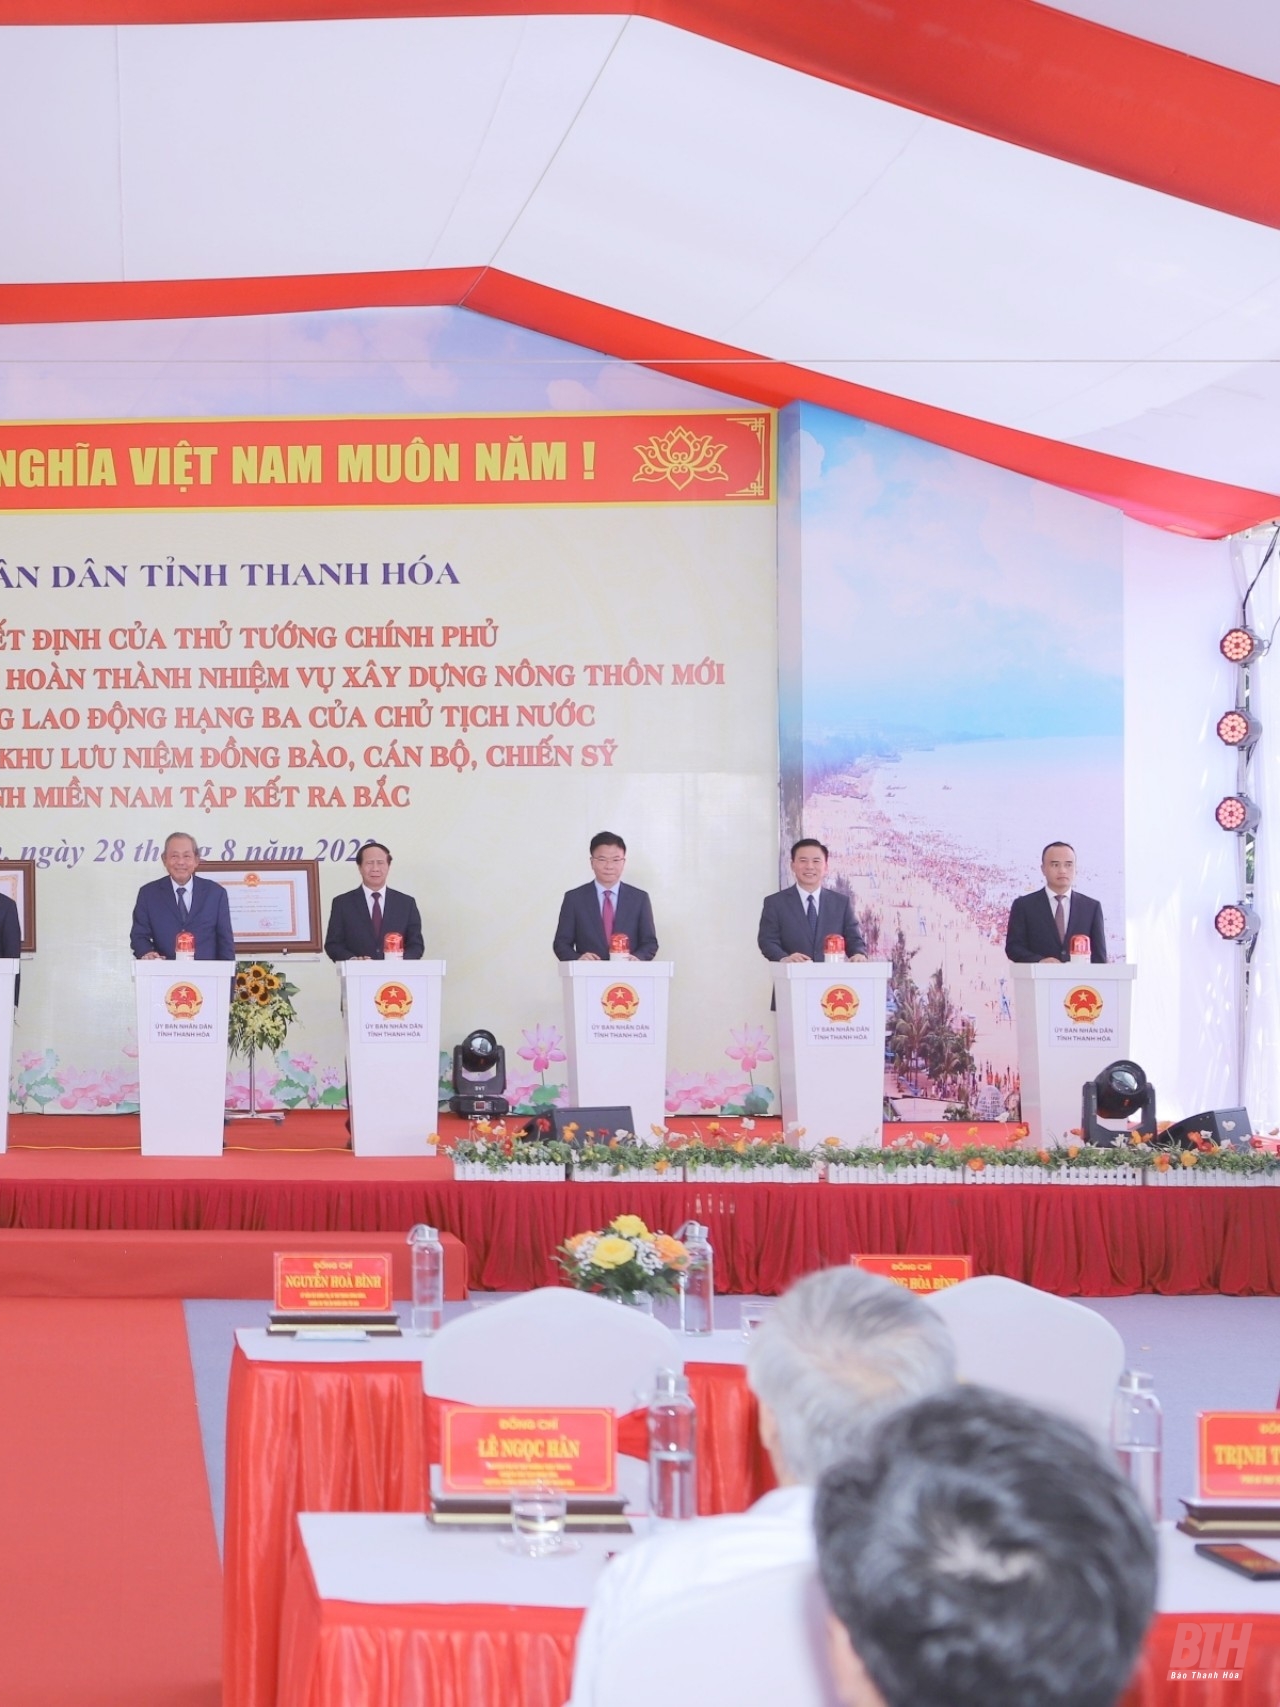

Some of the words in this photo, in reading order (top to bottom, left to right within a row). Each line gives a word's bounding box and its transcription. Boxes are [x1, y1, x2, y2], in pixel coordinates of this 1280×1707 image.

[128, 439, 219, 493] VIỆT
[232, 444, 322, 485] NAM
[337, 436, 460, 484] MUÔN
[475, 435, 567, 482] NĂM
[583, 442, 595, 480] !
[52, 559, 128, 588] DÂN
[139, 559, 228, 587] TỈNH
[240, 562, 369, 587] THANH
[382, 557, 460, 585] HÓA
[31, 628, 102, 656] ĐỊNH
[108, 620, 167, 651] CỦA
[173, 619, 233, 650] THỦ
[239, 619, 338, 650] TƯỚNG
[344, 619, 435, 649] CHÍNH
[441, 617, 499, 648] PHỦ
[5, 661, 87, 691] HOÀN
[92, 660, 192, 690] THÀNH
[198, 659, 290, 695] NHIỆM
[295, 666, 336, 694] VỤ
[341, 659, 402, 688] XÂY
[408, 662, 488, 694] DỰNG
[494, 658, 576, 687] NÔNG
[583, 657, 664, 686] THÔN
[671, 657, 725, 685] MỚI
[21, 707, 81, 730] LAO
[86, 700, 167, 735] ĐỘNG
[174, 706, 255, 735] HẠNG
[261, 706, 302, 729] BA
[308, 698, 368, 729] CỦA
[374, 698, 434, 729] CHỦ
[440, 704, 510, 733] TỊCH
[516, 697, 595, 727] NƯỚC
[60, 744, 117, 770] LƯU
[122, 740, 194, 775] NIỆM
[200, 738, 281, 769] ĐỒNG
[287, 739, 355, 772] BÀO,
[363, 738, 424, 768] CÁN
[429, 738, 478, 773] BỘ,
[485, 736, 574, 768] CHIẾN
[581, 739, 618, 767] SỸ
[32, 778, 104, 808] MIỀN
[109, 786, 173, 808] NAM
[180, 779, 237, 814] TẬP
[244, 777, 300, 808] KẾT
[307, 785, 347, 808] RA
[352, 776, 411, 808] BẮC
[20, 838, 85, 869] ngày
[93, 838, 126, 862] 28
[220, 838, 237, 861] 8
[245, 837, 304, 861] năm
[314, 838, 377, 862] 202
[285, 1270, 329, 1288] NGUYỄN
[355, 1272, 382, 1289] BÌNH
[1213, 1444, 1267, 1470] TRỊNH
